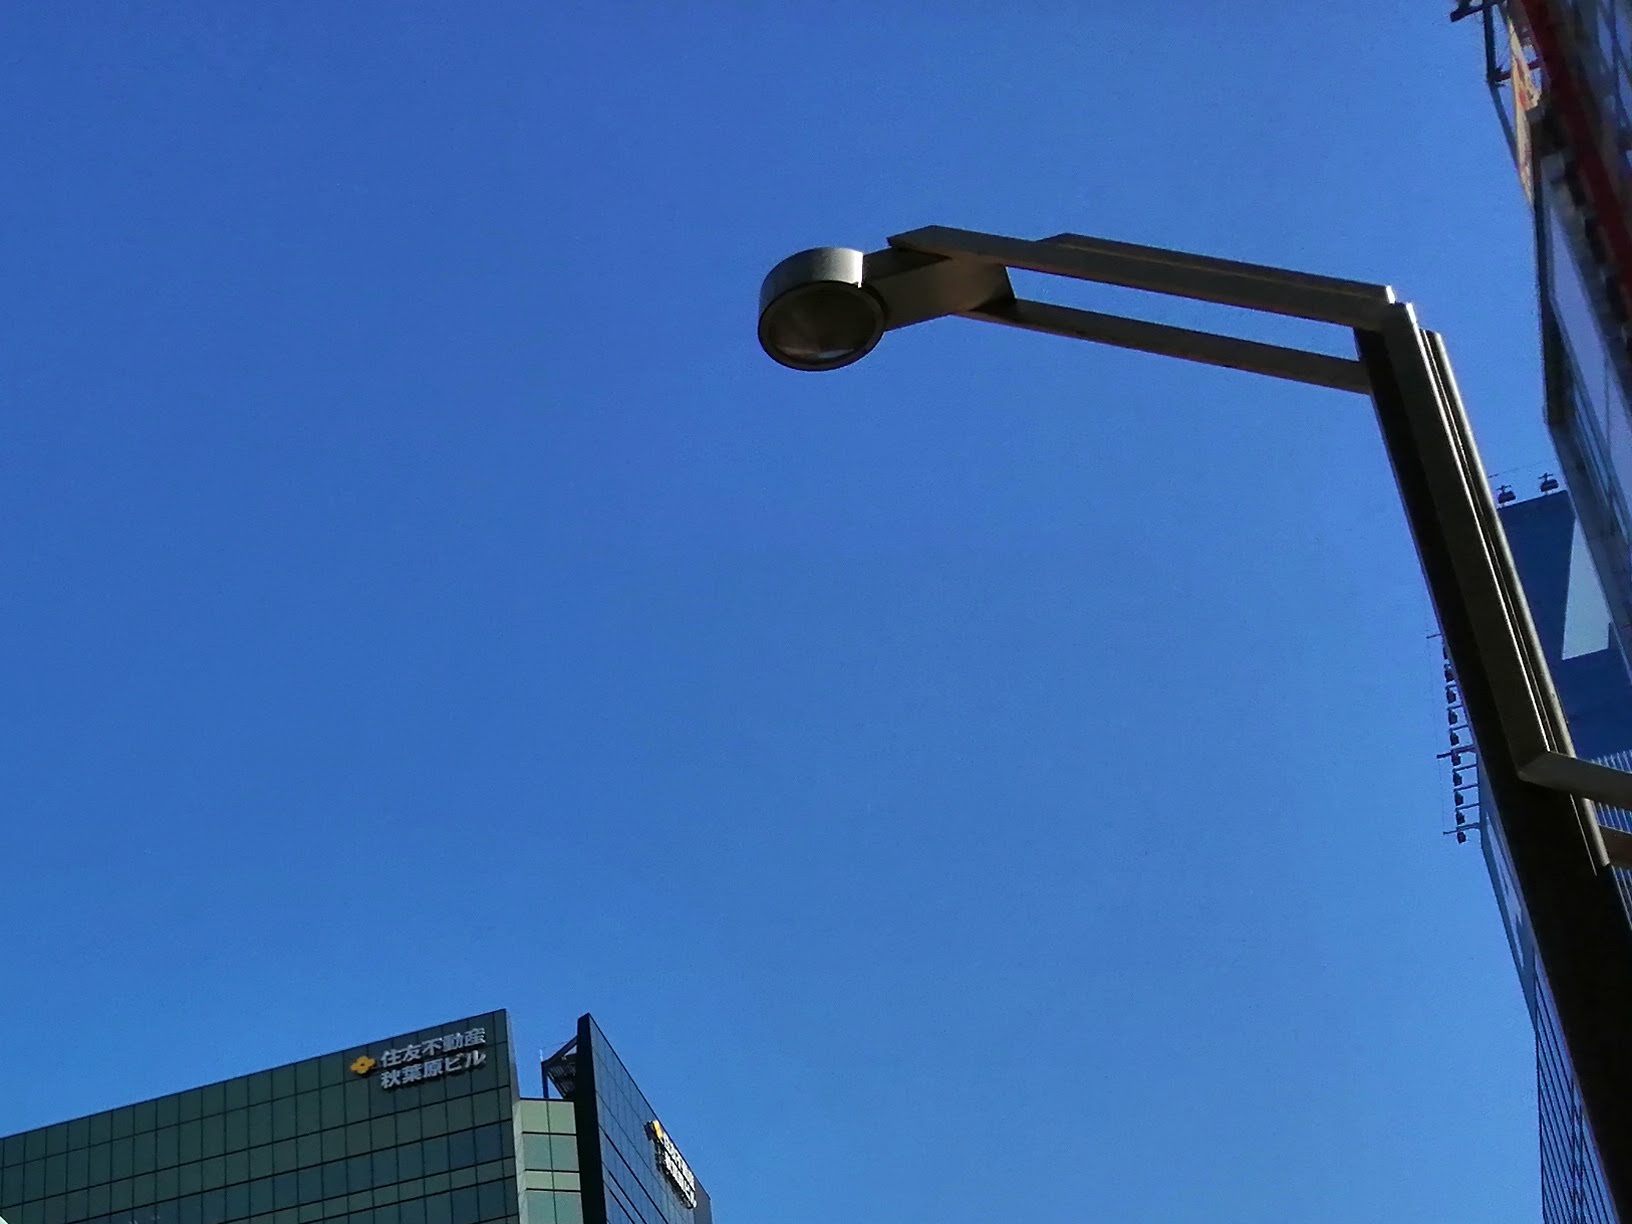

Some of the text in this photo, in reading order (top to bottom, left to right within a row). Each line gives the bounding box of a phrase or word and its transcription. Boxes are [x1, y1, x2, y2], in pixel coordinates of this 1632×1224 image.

[380, 1027, 486, 1068] 住友不動産
[380, 1050, 486, 1090] 秋葉原ビル
